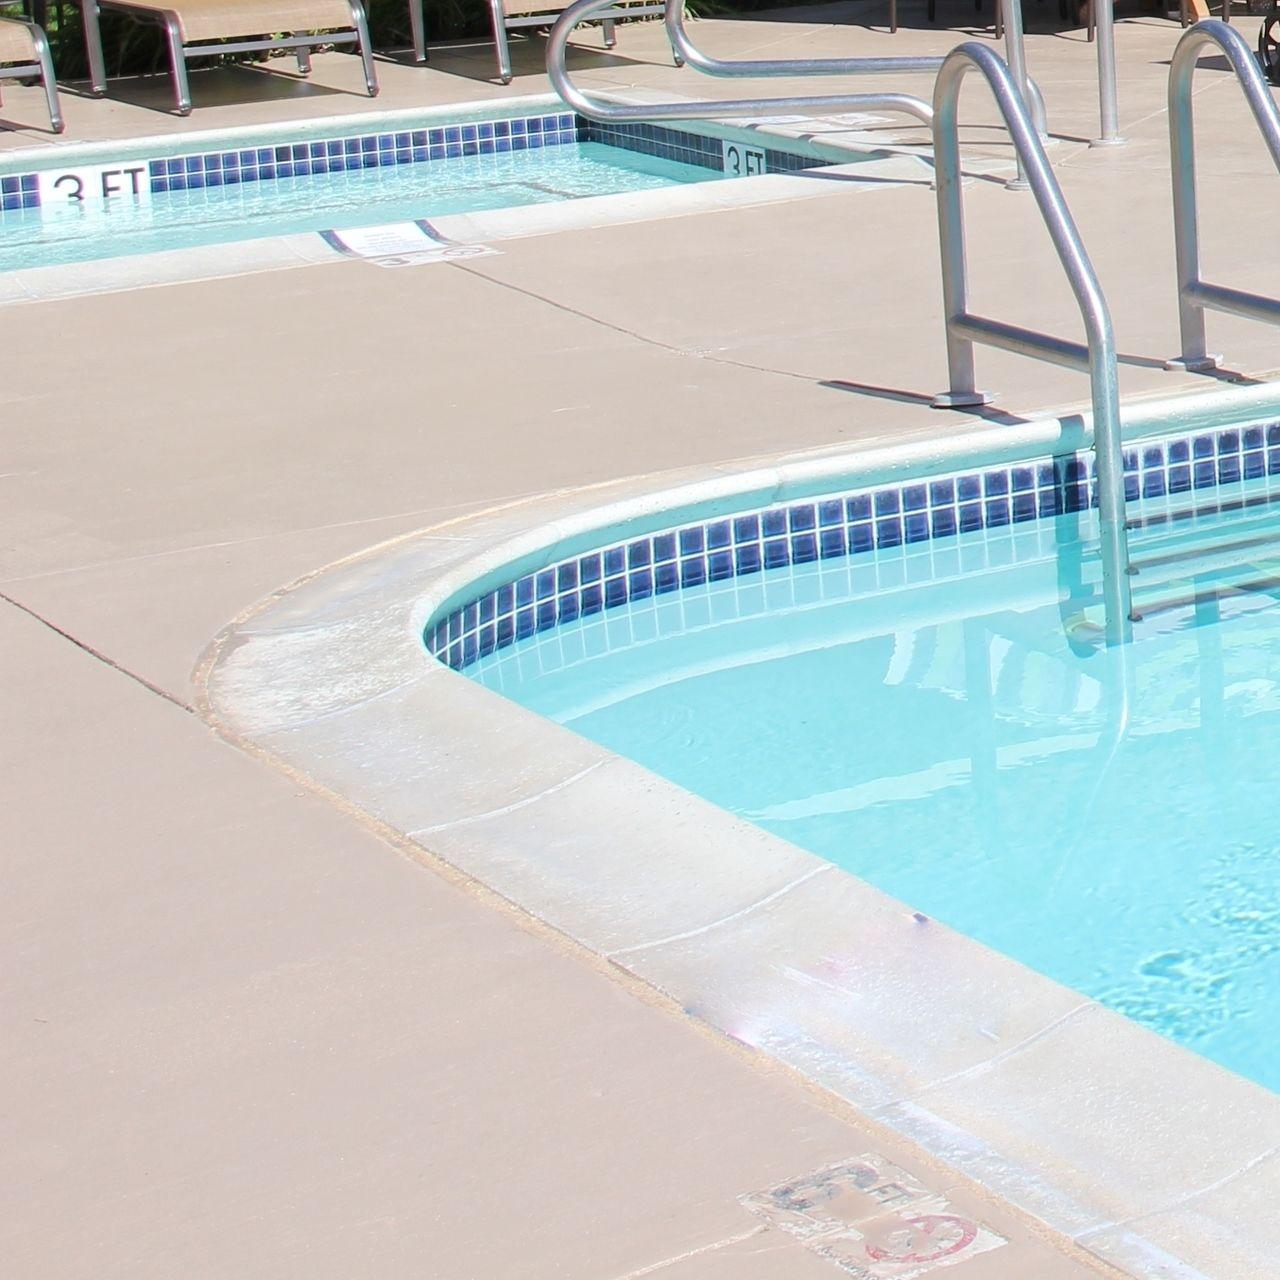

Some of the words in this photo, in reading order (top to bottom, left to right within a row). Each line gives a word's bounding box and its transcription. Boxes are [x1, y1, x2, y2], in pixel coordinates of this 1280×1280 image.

[728, 146, 740, 175] 3
[745, 150, 764, 177] FT
[53, 174, 84, 201] 3
[101, 167, 146, 198] FT
